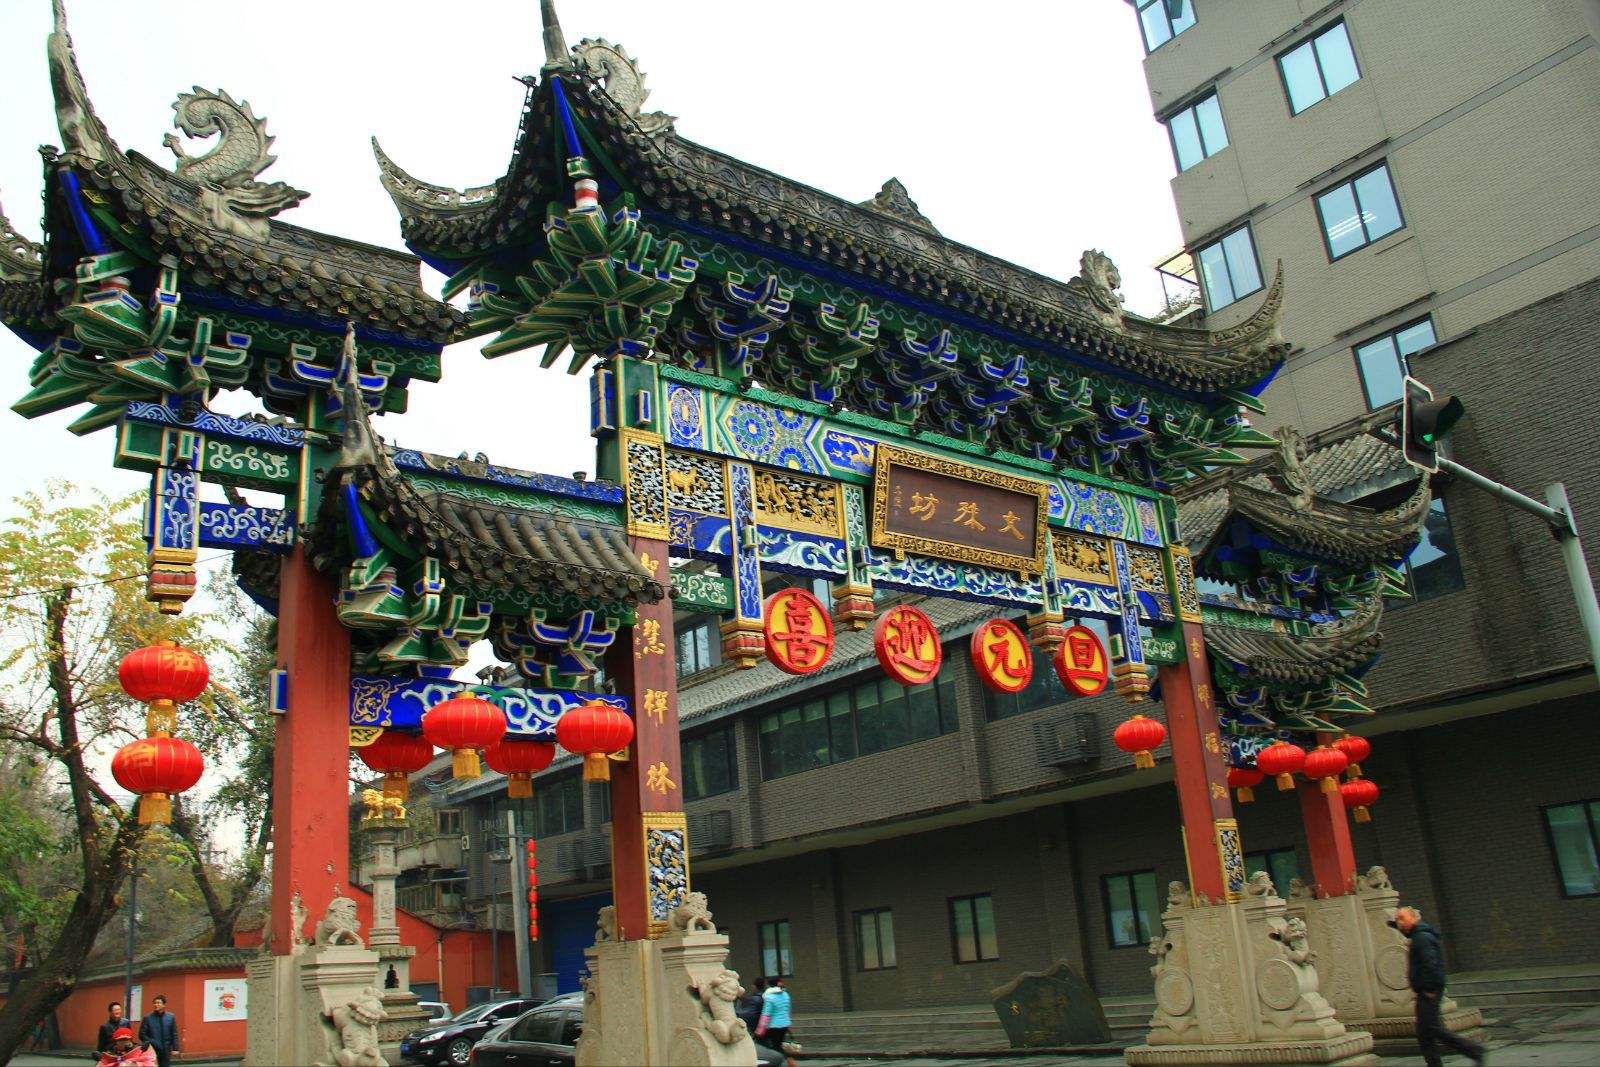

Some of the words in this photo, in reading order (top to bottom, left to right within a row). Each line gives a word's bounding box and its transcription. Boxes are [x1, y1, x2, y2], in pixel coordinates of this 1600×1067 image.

[909, 492, 1025, 541] 文殊坊
[772, 593, 1108, 681] 喜迎元旦
